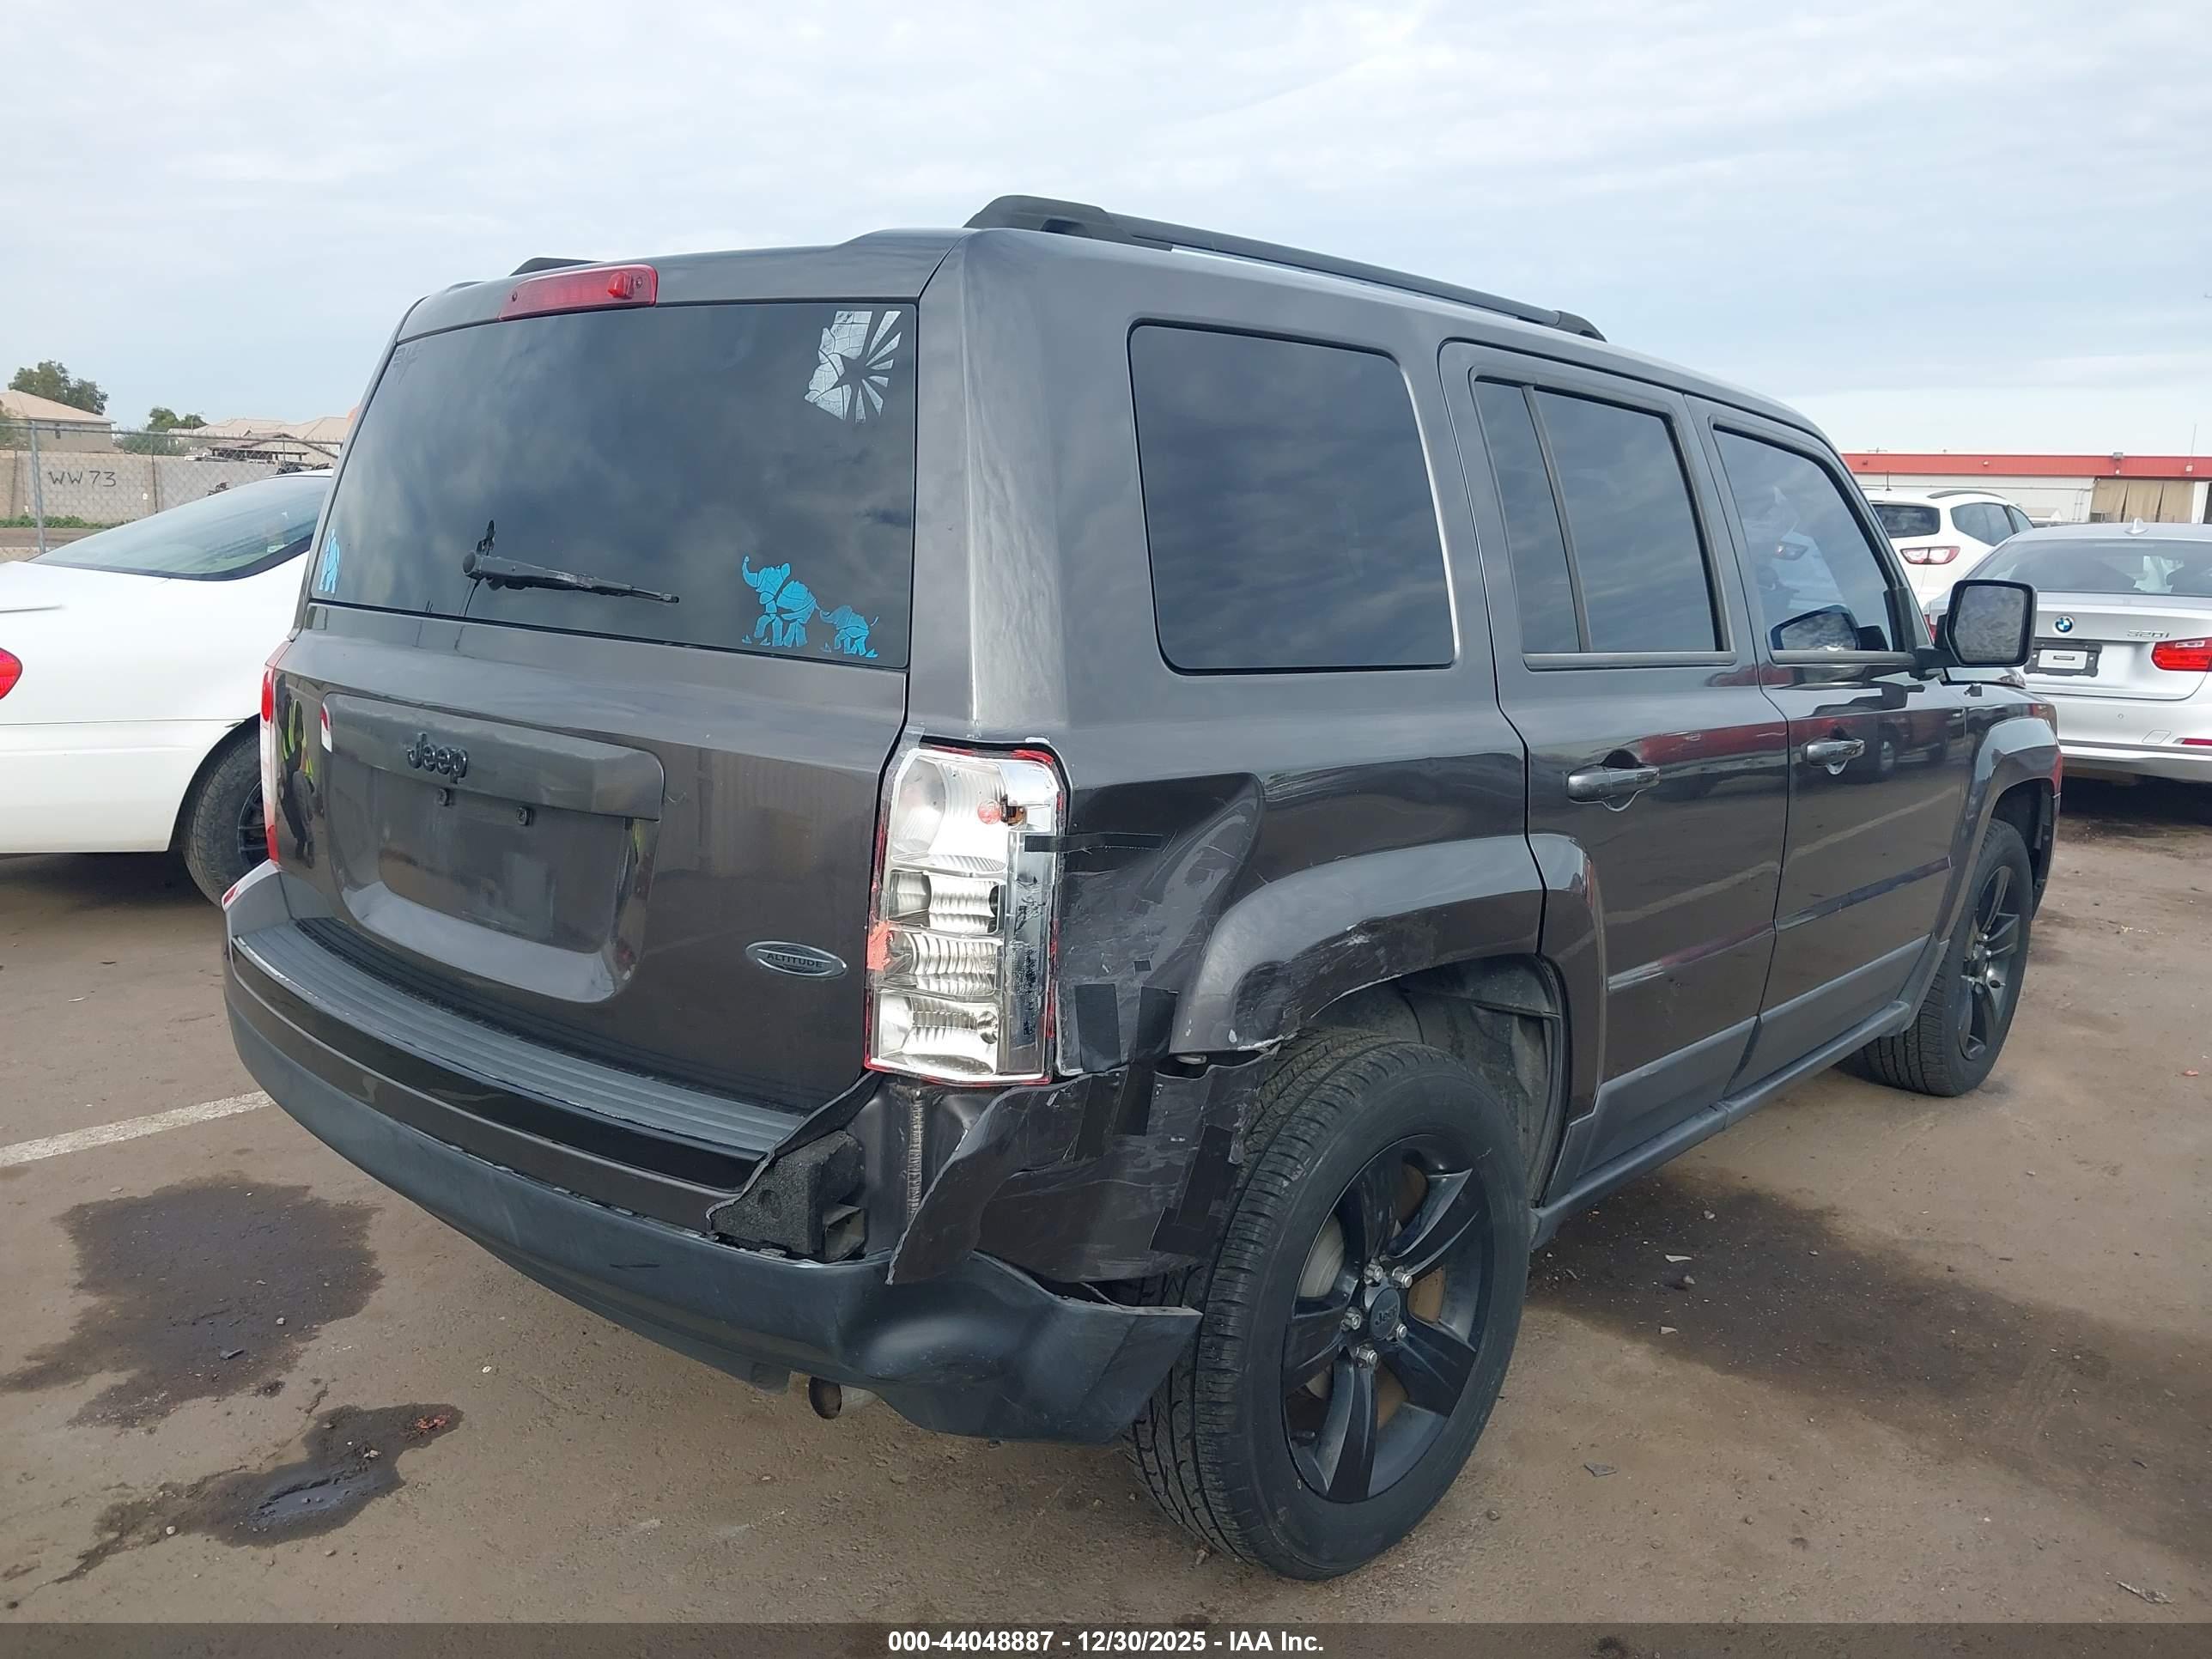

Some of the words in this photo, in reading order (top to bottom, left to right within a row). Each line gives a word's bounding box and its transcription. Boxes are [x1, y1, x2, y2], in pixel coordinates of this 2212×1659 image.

[48, 471, 83, 485] WW
[88, 470, 117, 489] 73
[406, 732, 468, 785] Jeep
[767, 952, 823, 968] ALTITUDE
